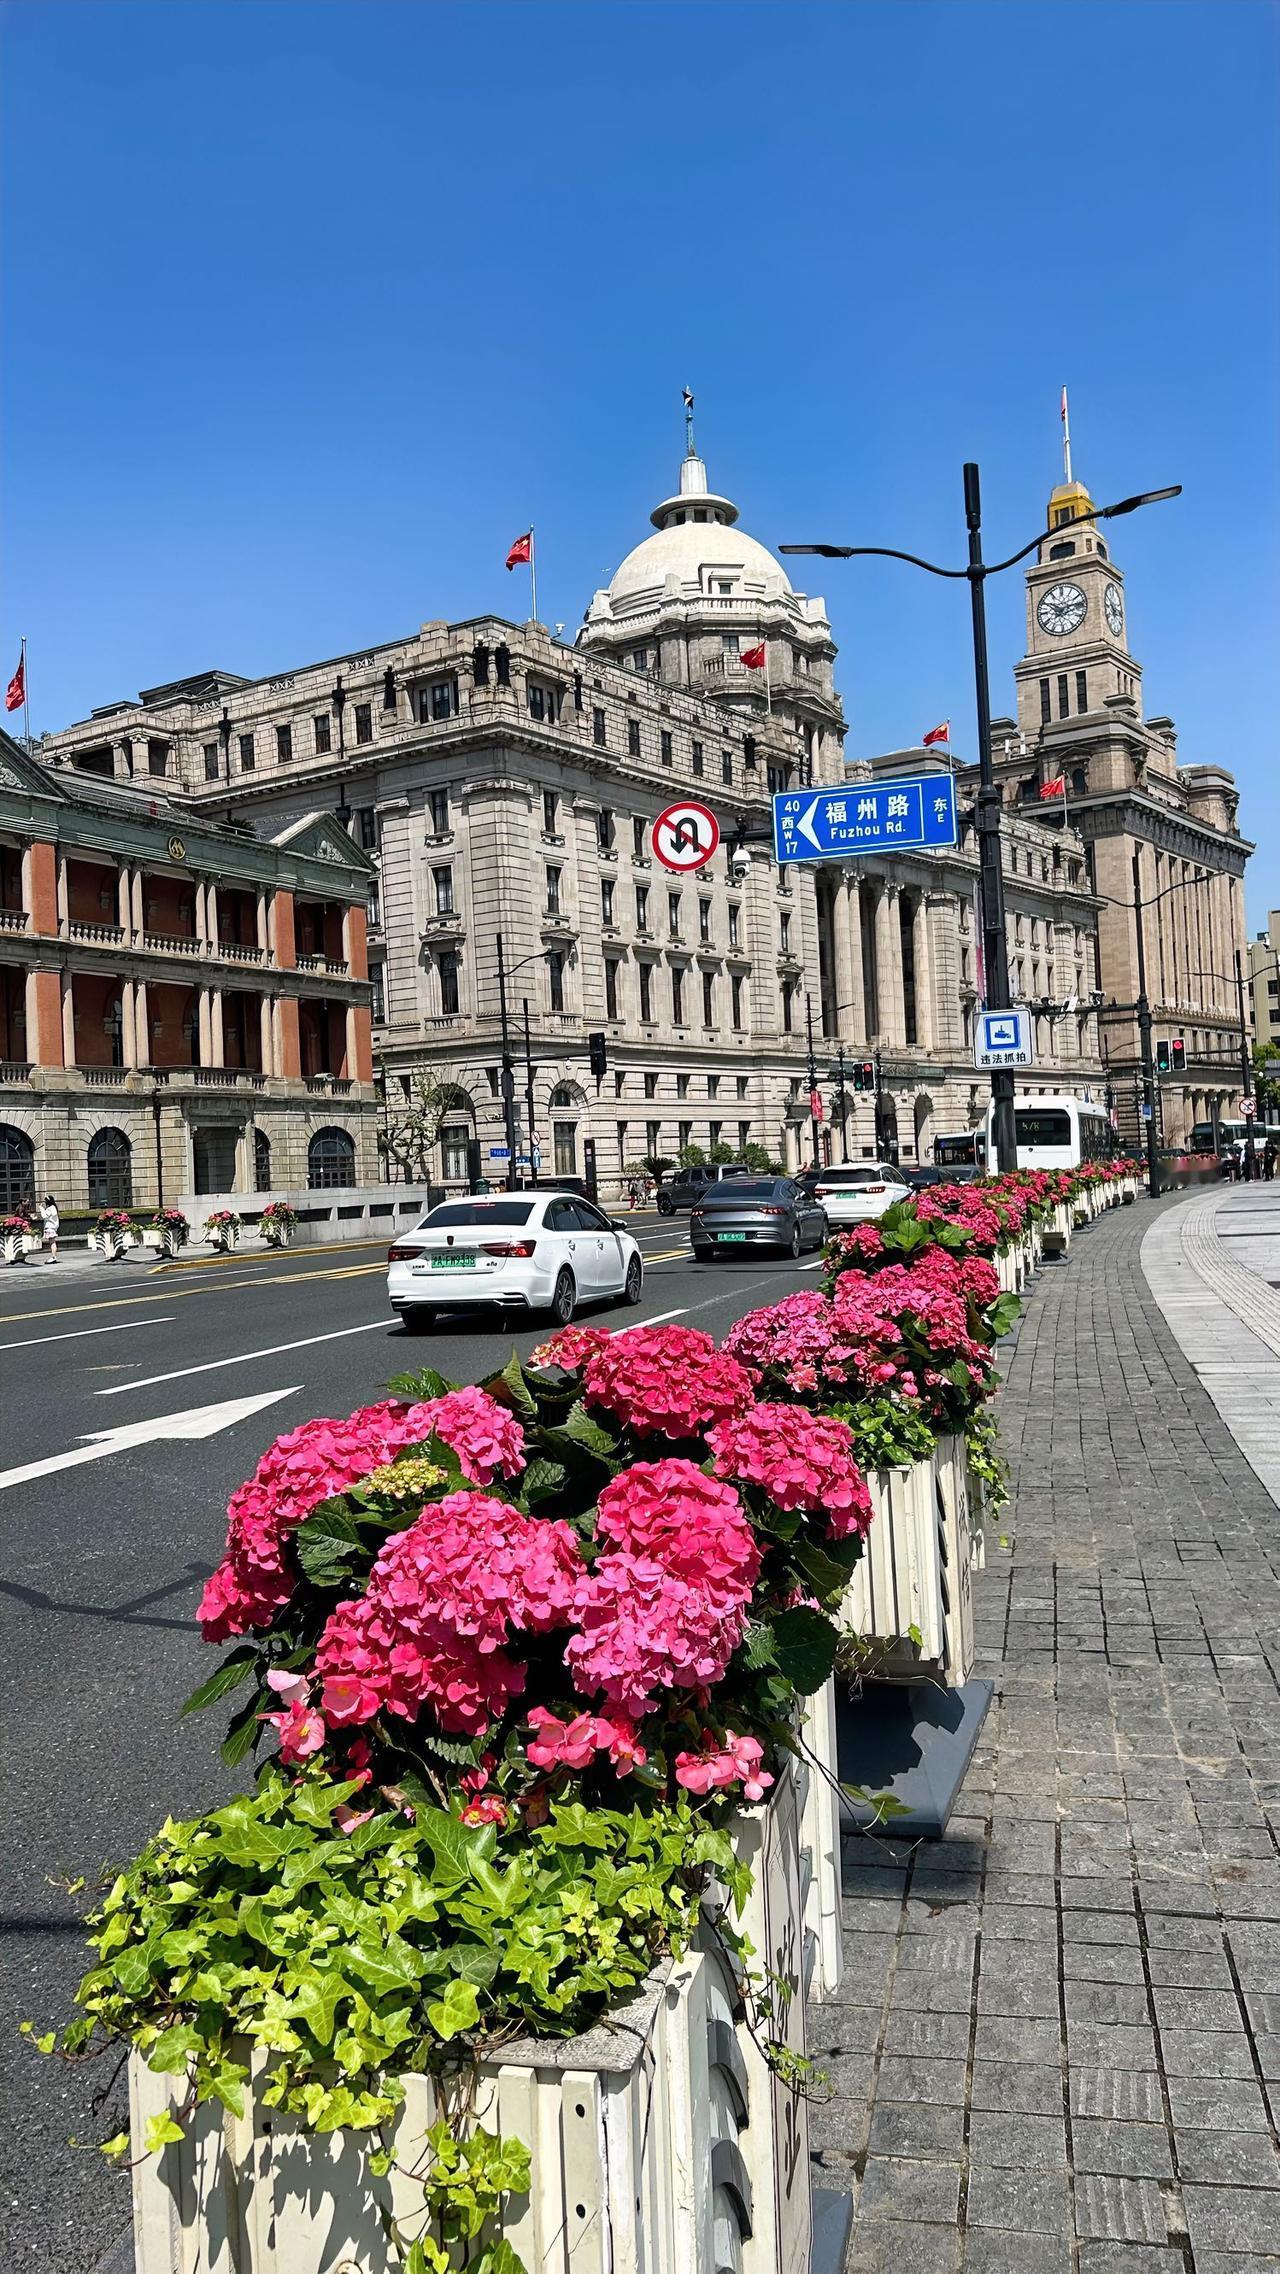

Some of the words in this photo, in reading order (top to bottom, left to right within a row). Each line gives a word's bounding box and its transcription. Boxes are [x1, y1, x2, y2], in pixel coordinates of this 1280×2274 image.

[784, 800, 800, 813] 40
[825, 794, 910, 824] 福州路
[933, 797, 948, 812] 东
[780, 816, 795, 830] 西
[937, 813, 945, 823] E
[783, 830, 793, 840] W
[830, 825, 880, 840] Fuzhou
[886, 820, 906, 834] Rd.
[785, 841, 798, 854] 17
[981, 1052, 1026, 1064] 违法抓拍
